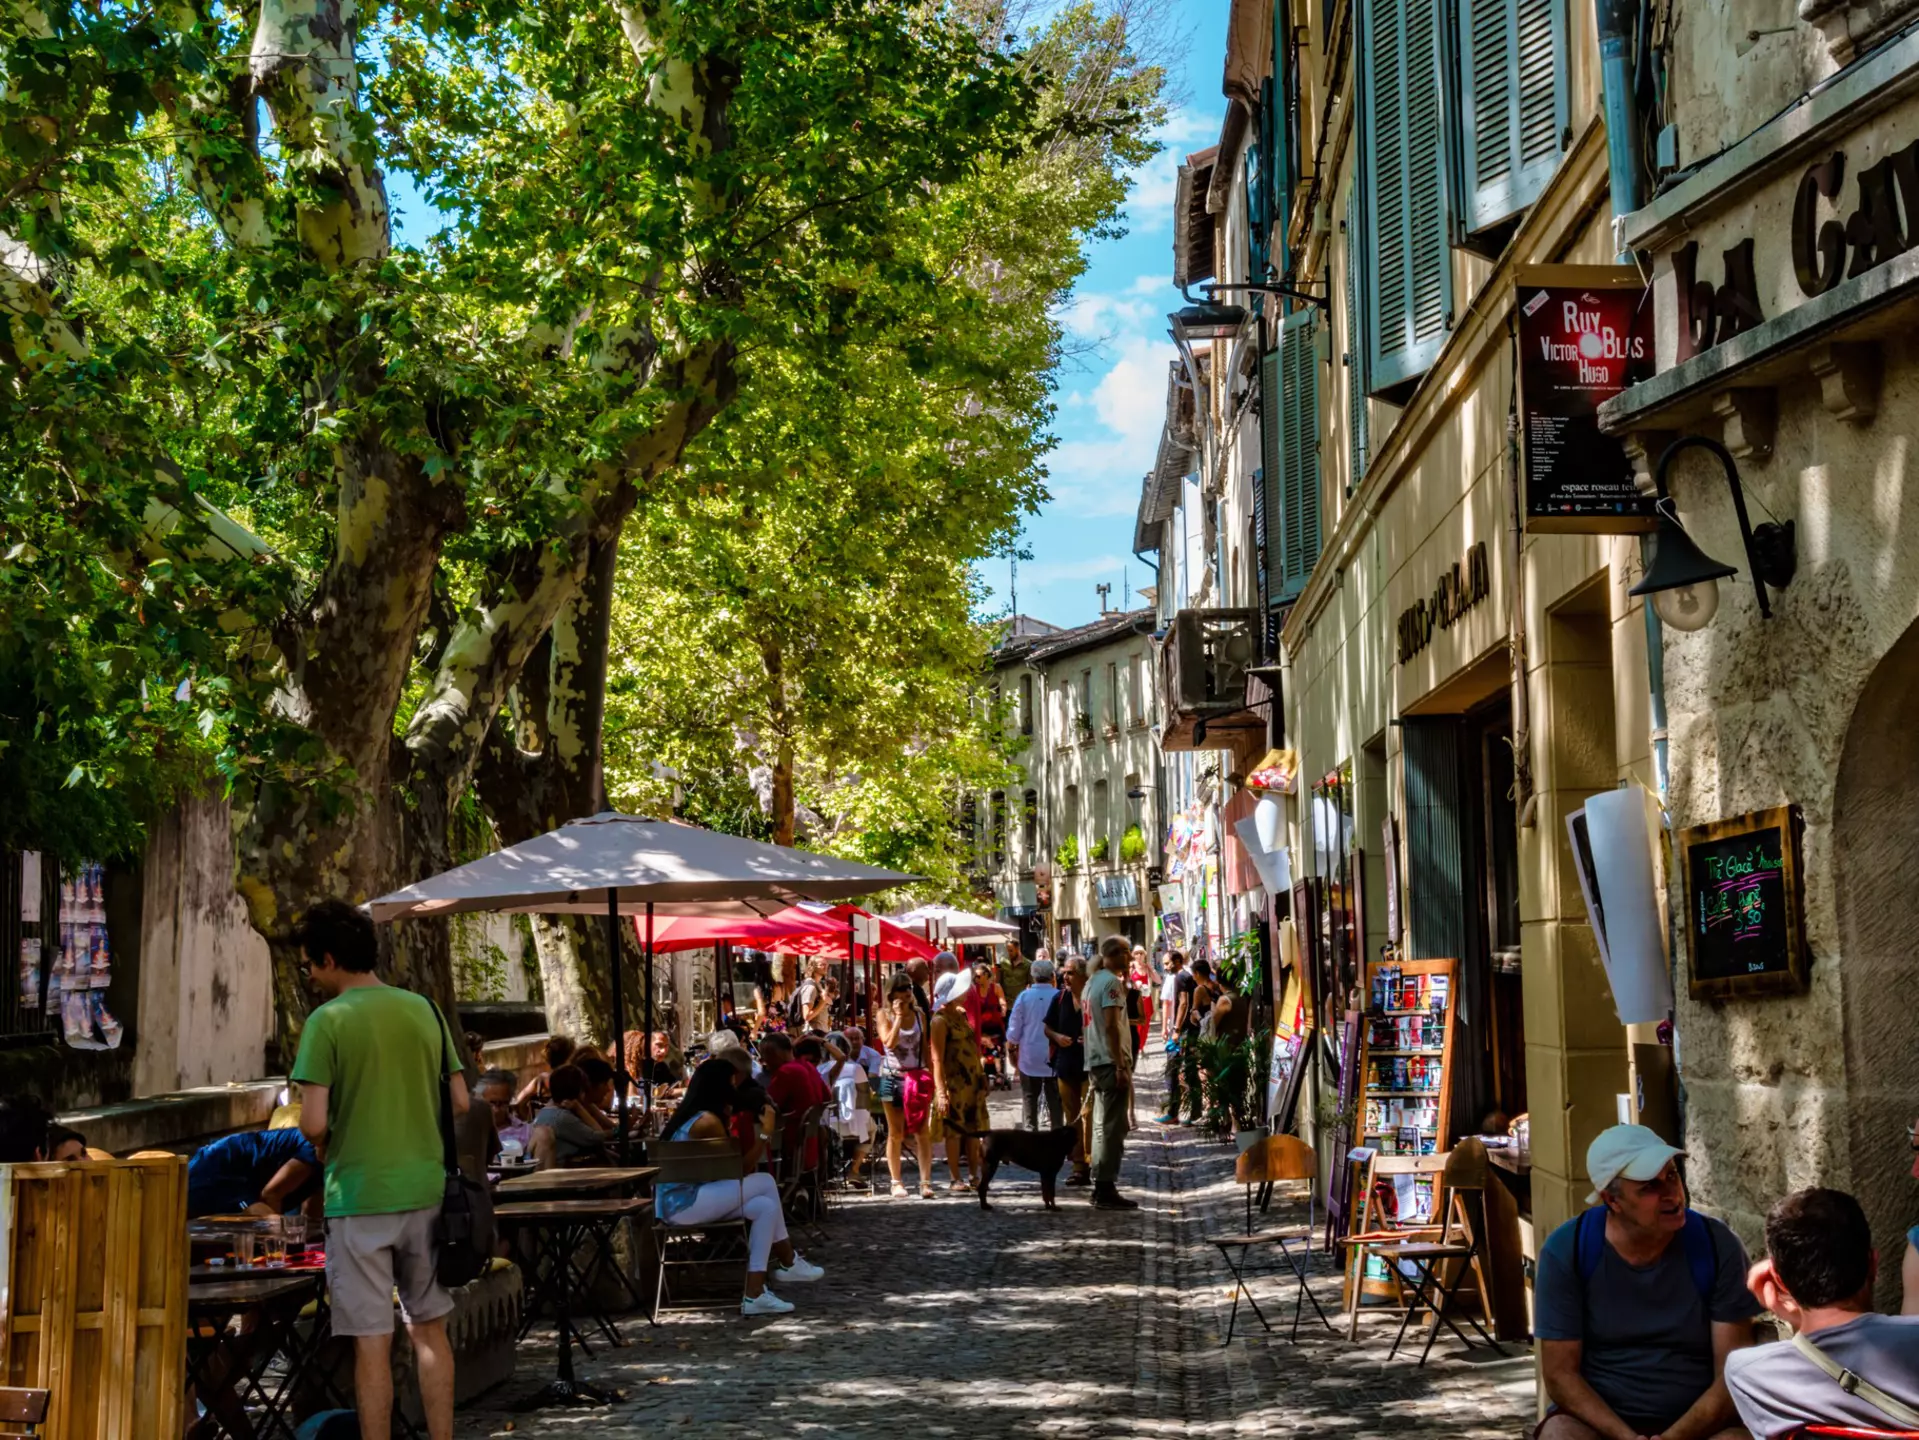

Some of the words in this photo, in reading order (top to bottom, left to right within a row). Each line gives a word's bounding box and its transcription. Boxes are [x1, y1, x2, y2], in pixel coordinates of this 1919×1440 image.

[1562, 301, 1600, 333] RUY
[1671, 238, 1765, 365] LA
[1540, 336, 1579, 361] VICTOR
[1579, 359, 1609, 383] HUGO
[1561, 484, 1589, 493] espace
[1591, 484, 1619, 492] roseau
